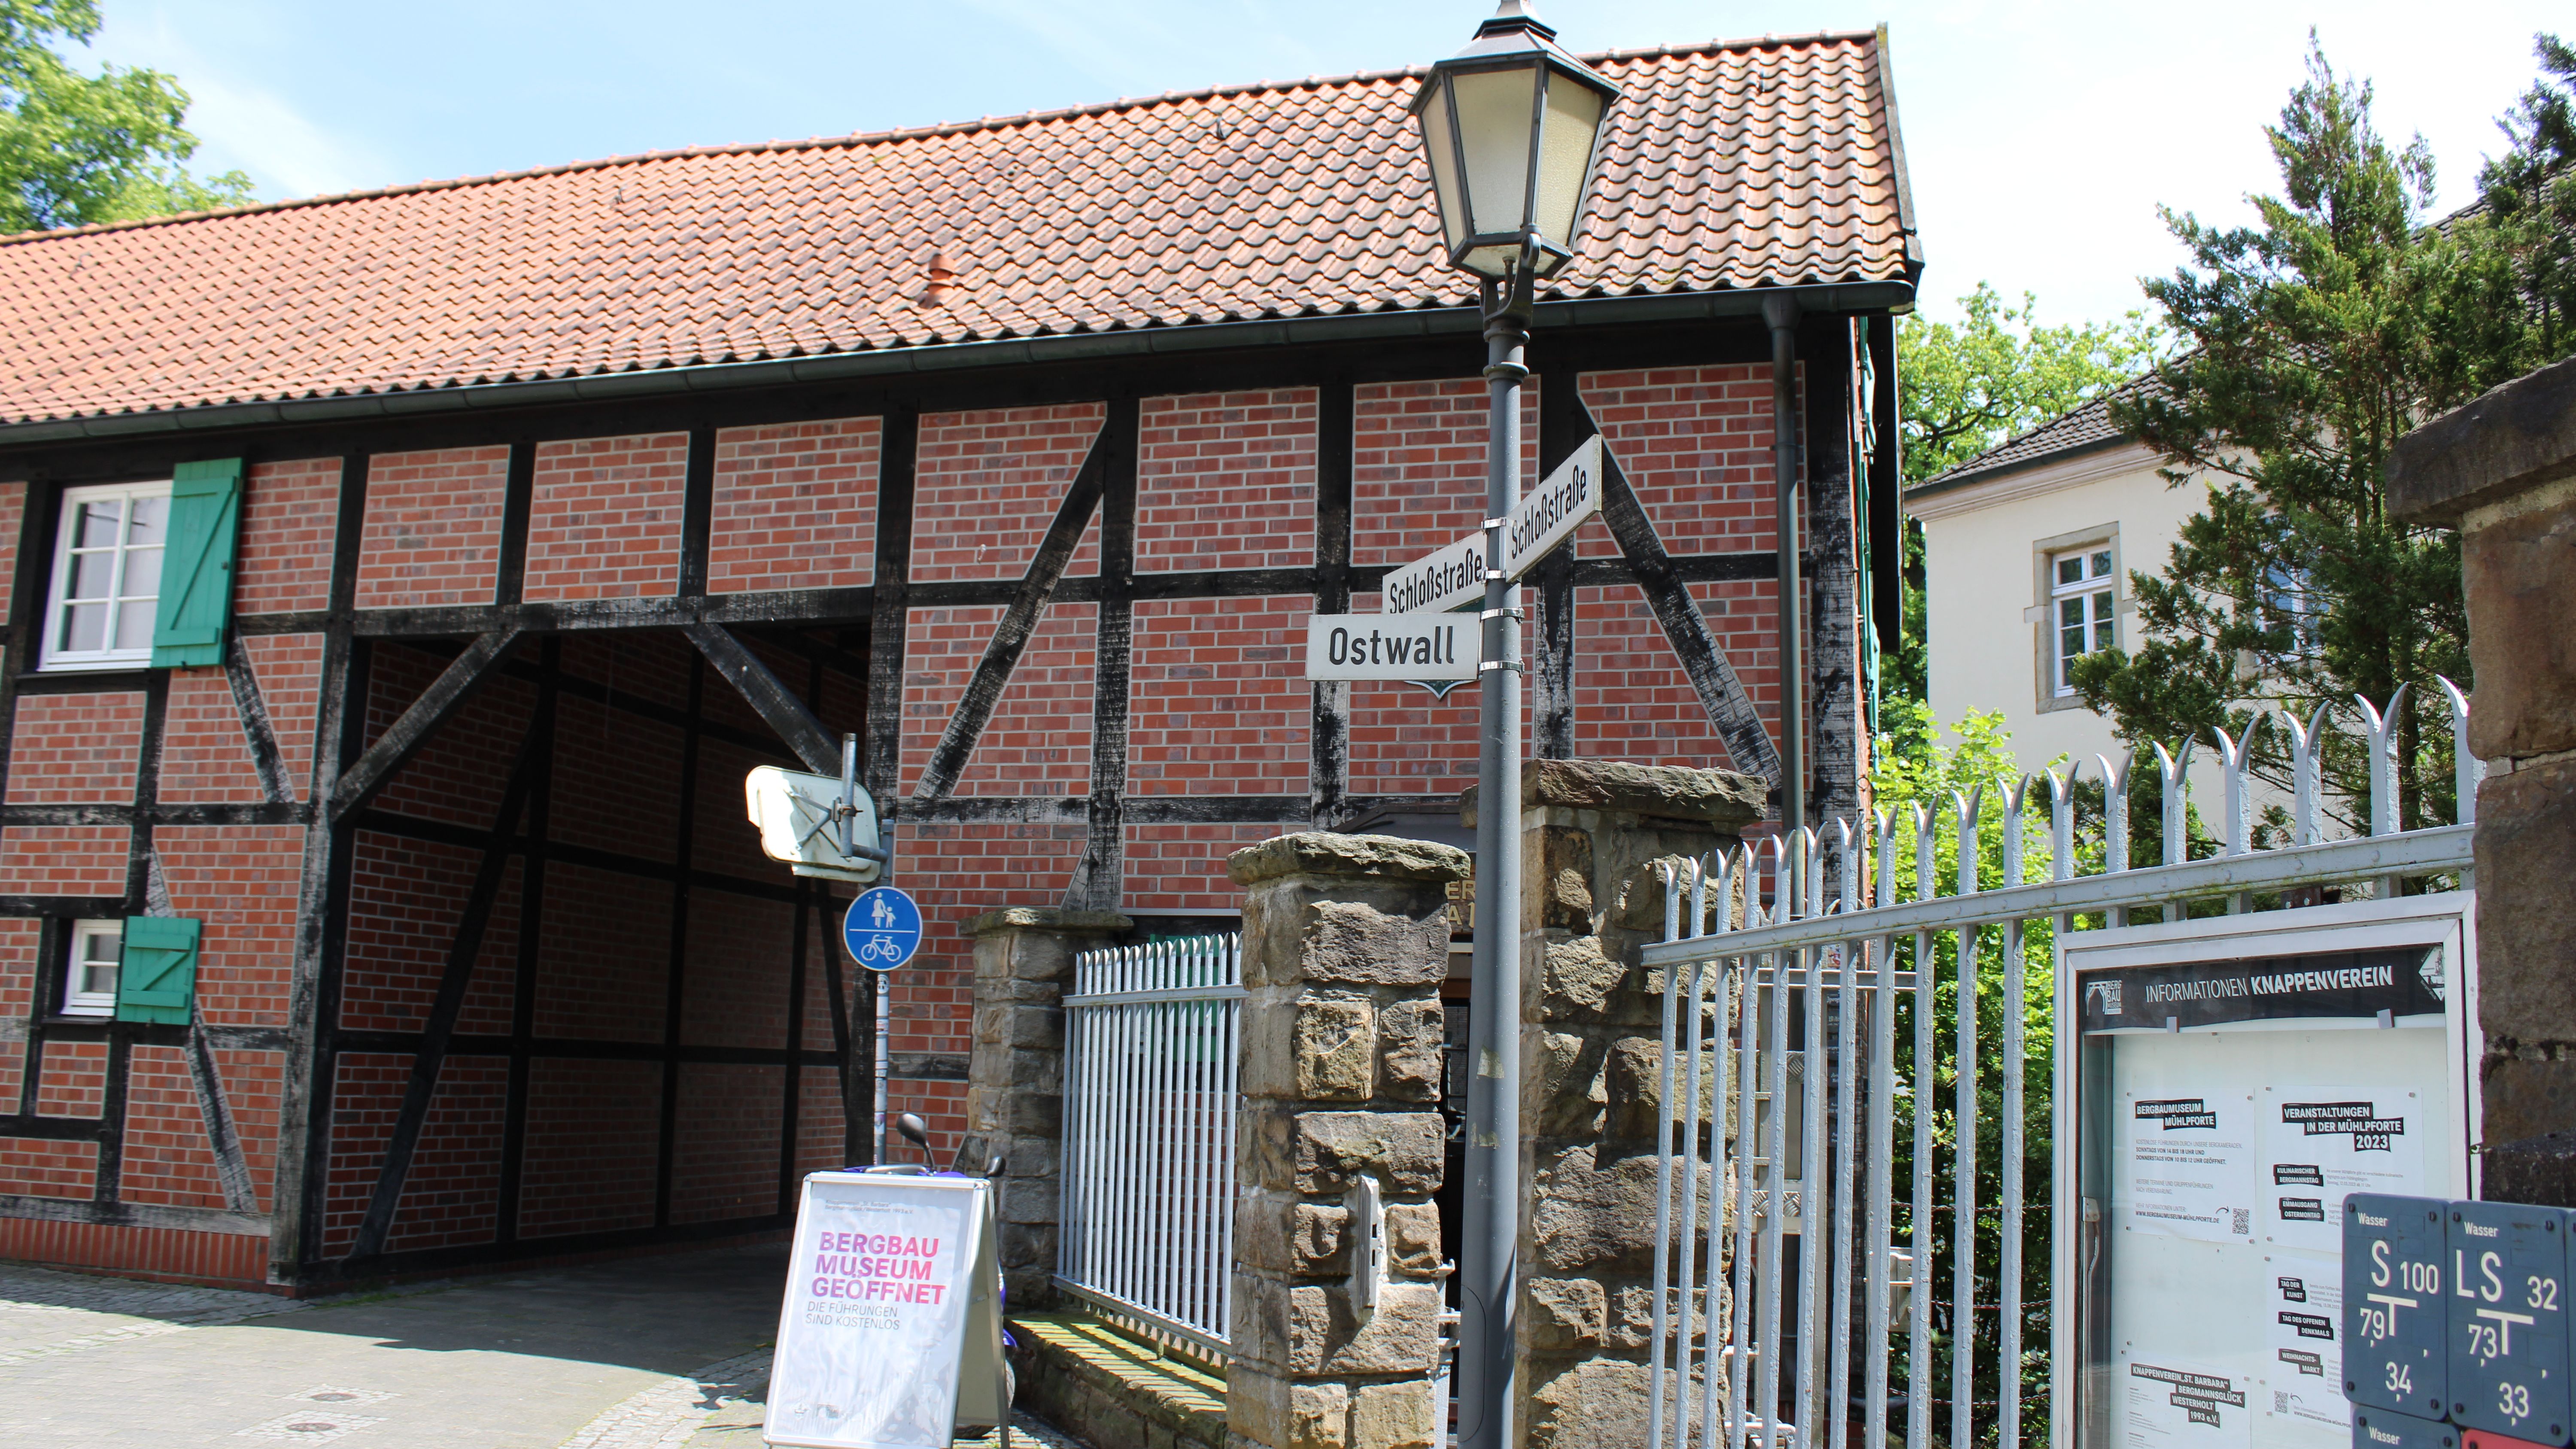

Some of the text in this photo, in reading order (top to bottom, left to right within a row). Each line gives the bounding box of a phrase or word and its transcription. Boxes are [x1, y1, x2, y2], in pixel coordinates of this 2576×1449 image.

[1511, 465, 1586, 559] Schloßstraße
[1390, 548, 1483, 614] Schloßstraße
[1329, 626, 1454, 665] Ostwall
[2107, 980, 2122, 990] BERG
[2146, 978, 2248, 1002] INFORMATIONEN
[2250, 965, 2393, 995] KNAPPENVEREIN
[2107, 989, 2121, 1002] BAU
[2136, 1103, 2202, 1115] BERGBAUMUSEUM
[2284, 1106, 2370, 1118] VERANSTALTUNGEN
[2164, 1115, 2215, 1127] MÜHLPFORTE
[2306, 1119, 2401, 1132] IN DER MÜHLPFORTE
[2356, 1134, 2388, 1149] 2023
[2145, 1203, 2172, 1212] INFORMATIONEN
[2136, 1210, 2219, 1223] WWW.BERGBAUMUSEUM-MÜHLPFORTE.DE
[2357, 1212, 2388, 1227] Wasser
[2464, 1221, 2499, 1238] Wasser
[819, 1232, 939, 1258] BERGBAU
[815, 1254, 933, 1280] MUSEUM
[2371, 1240, 2439, 1294] S 100
[2456, 1249, 2558, 1311] LS 32
[811, 1273, 946, 1305] GEÖFFNET
[807, 1301, 898, 1317] DIE FÜHRUNGEN
[805, 1313, 900, 1330] SIND KOSTENLOS
[2303, 1318, 2326, 1326] OFFENEN
[2301, 1327, 2330, 1337] DENKMALS
[2281, 1352, 2317, 1362] WEIHNACHTS-
[2302, 1365, 2320, 1373] MARKT
[2178, 1385, 2242, 1403] BERGMANNSGLÜCK
[2172, 1395, 2214, 1410] WESTERHOLT
[2190, 1411, 2219, 1424] 1993 e.V.
[2369, 1426, 2401, 1445] Wasser
